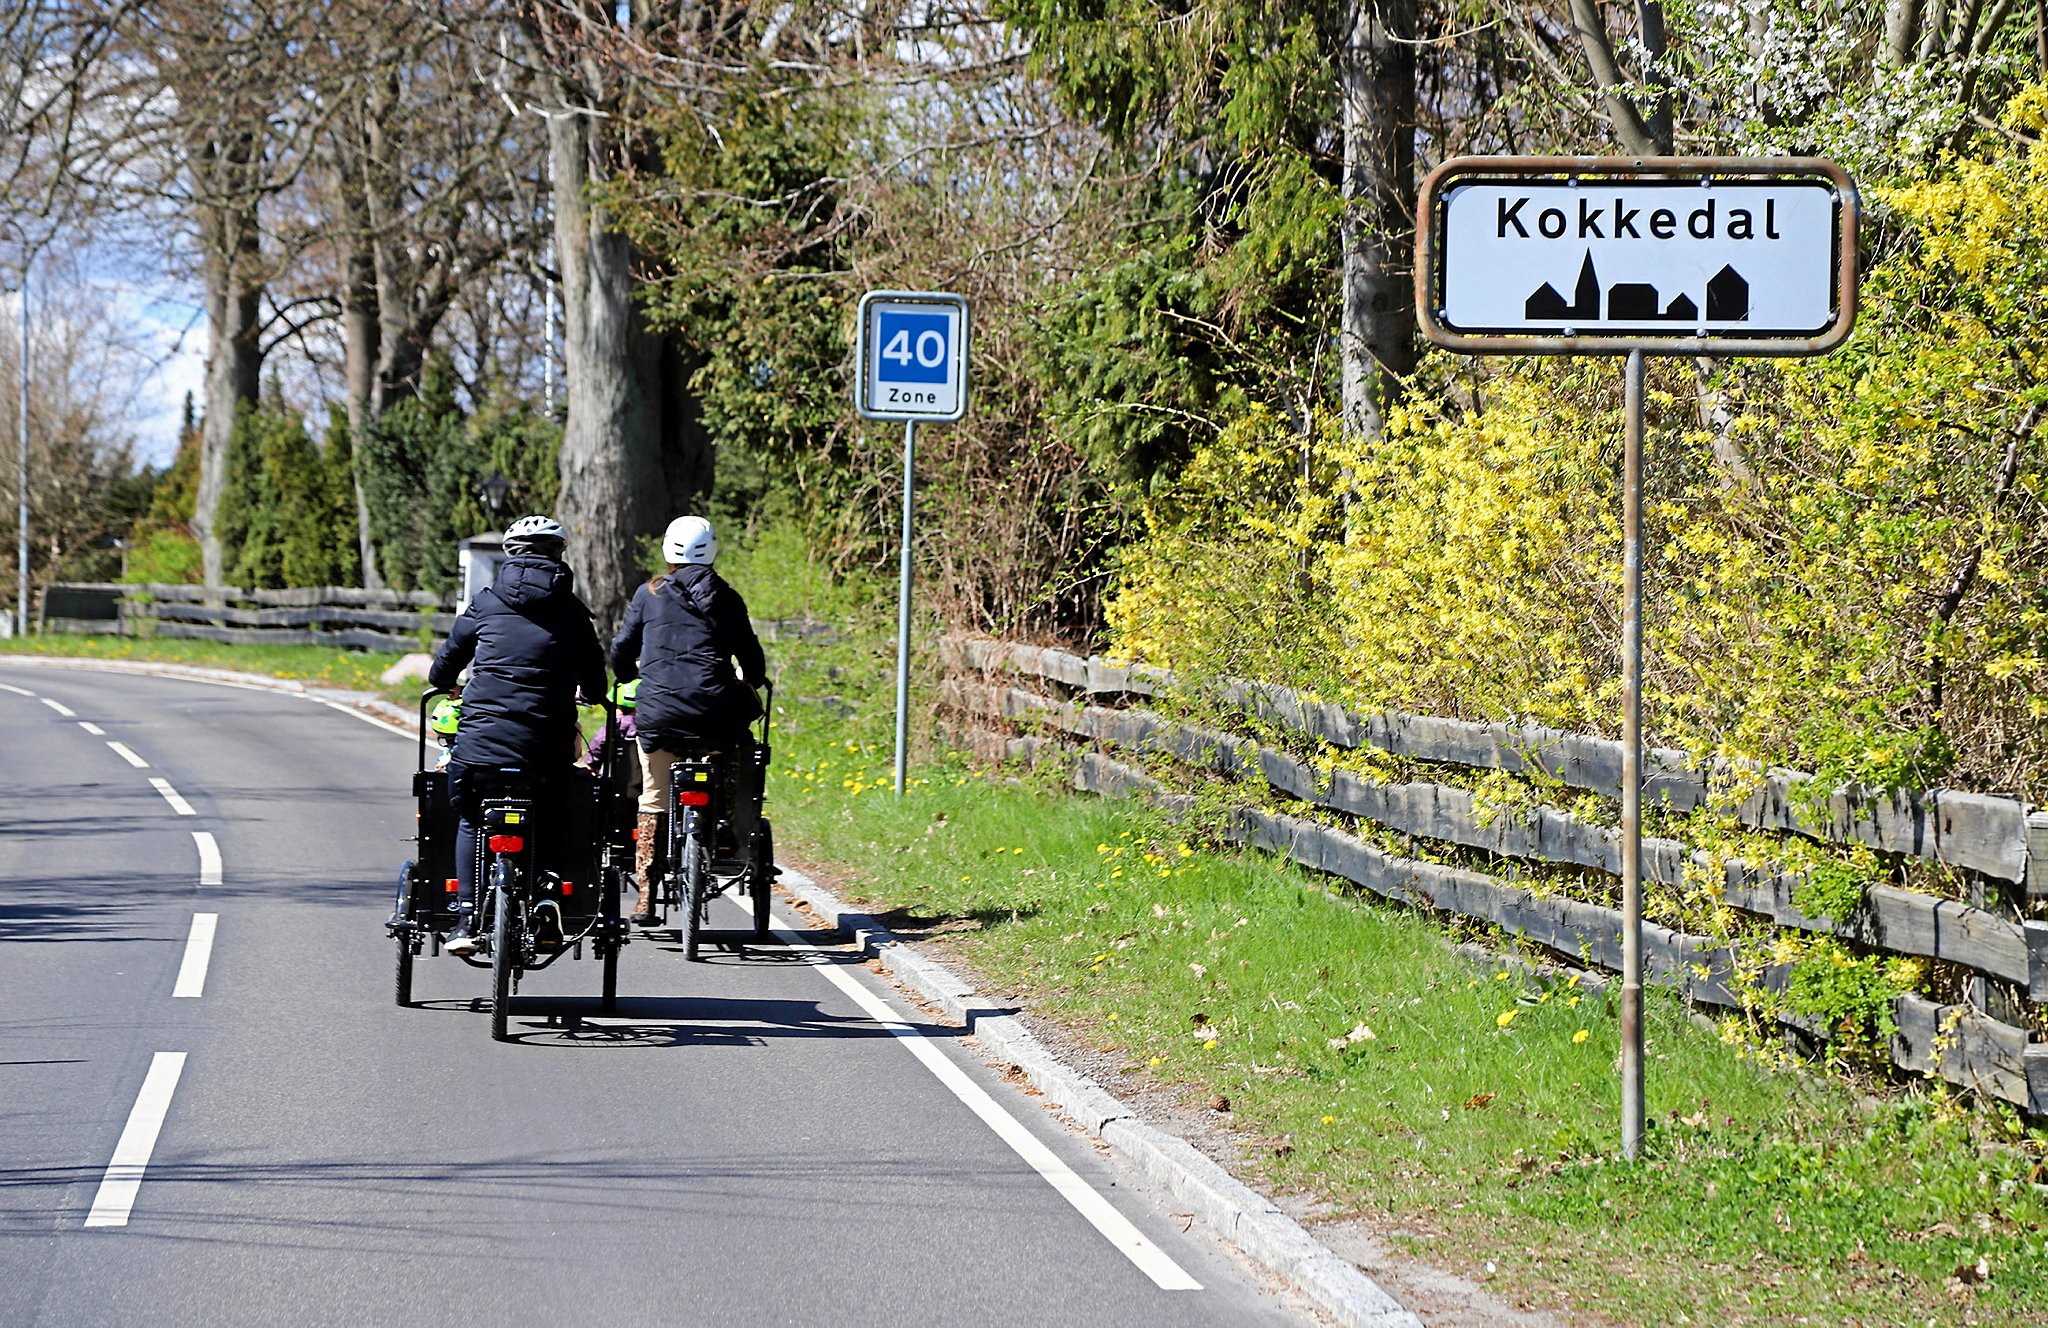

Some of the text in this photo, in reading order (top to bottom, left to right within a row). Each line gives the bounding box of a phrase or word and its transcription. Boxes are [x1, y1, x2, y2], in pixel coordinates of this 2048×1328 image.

[1497, 198, 1780, 239] Kokkedal
[882, 330, 945, 368] 40
[889, 388, 936, 403] Zone
